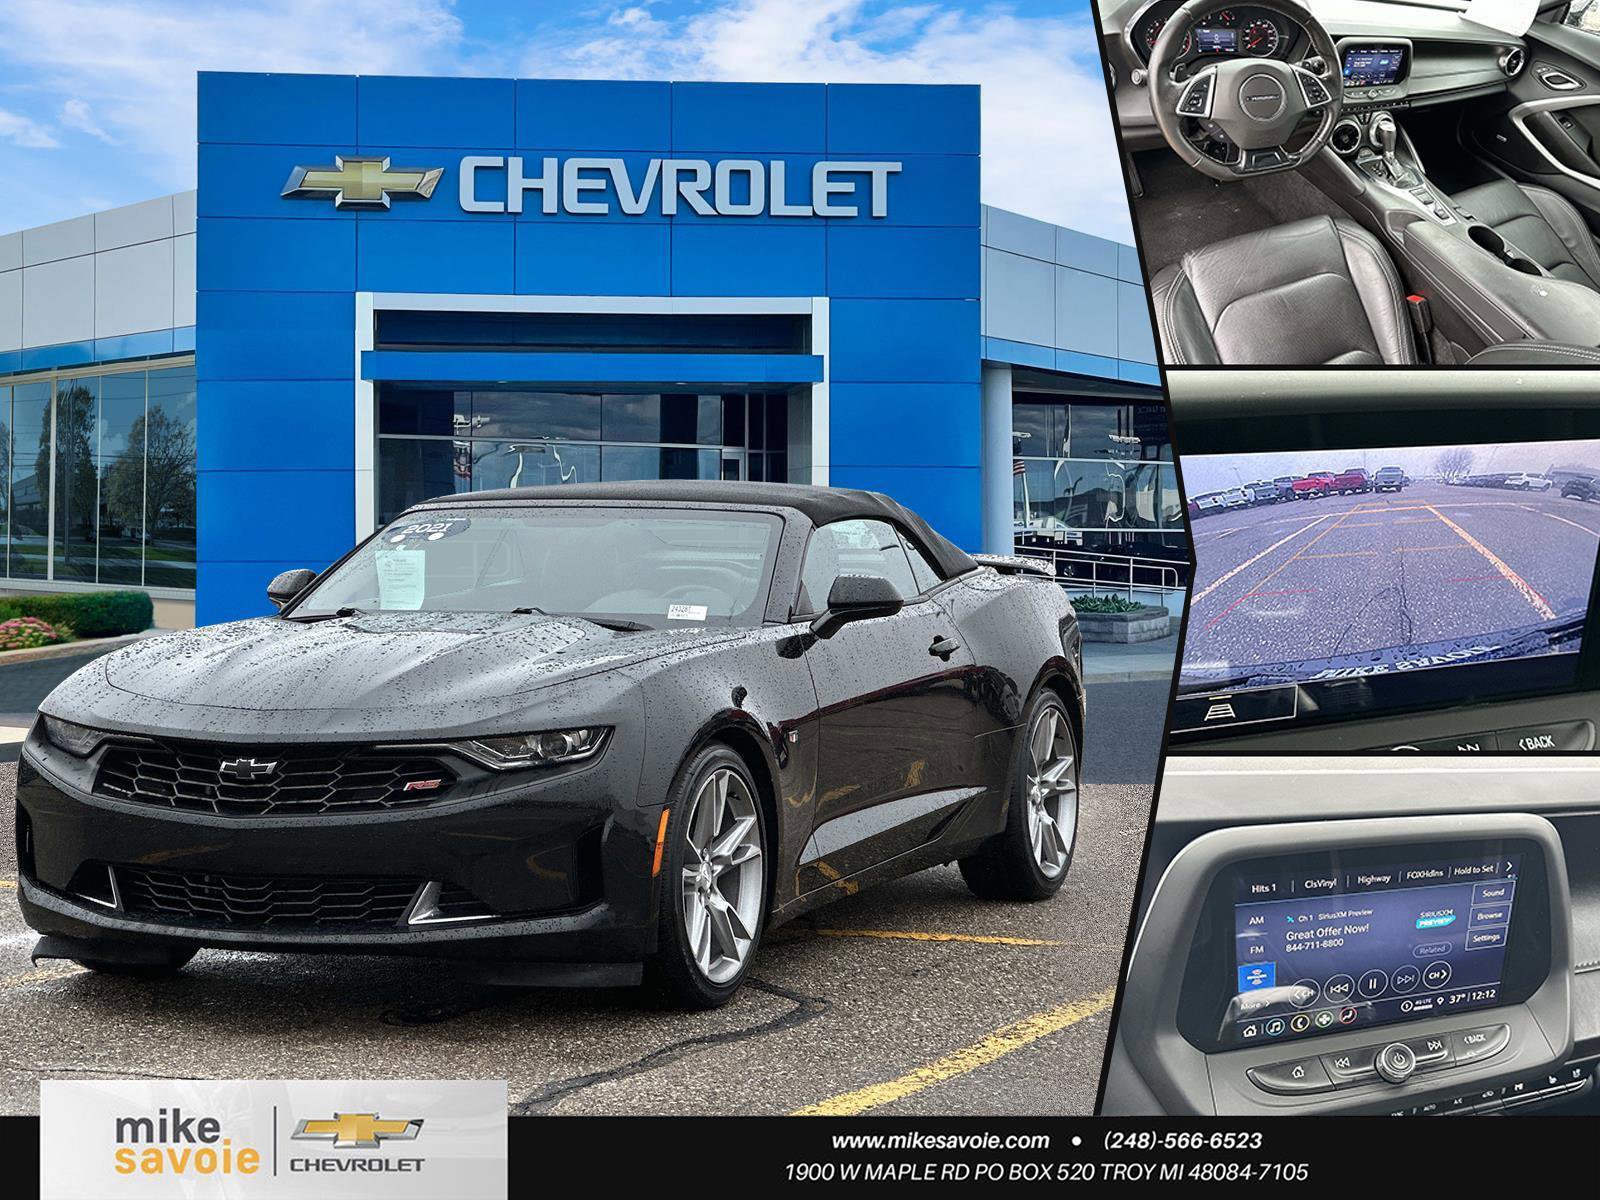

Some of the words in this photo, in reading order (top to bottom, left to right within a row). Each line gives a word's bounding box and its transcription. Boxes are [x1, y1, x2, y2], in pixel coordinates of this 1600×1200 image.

[459, 155, 903, 218] CHEVROLET
[402, 522, 453, 534] 2021
[1525, 735, 1556, 750] BACK
[403, 779, 441, 791] RS
[1454, 867, 1472, 876] Hold
[1472, 866, 1480, 874] to
[1481, 864, 1494, 873] Set
[1357, 873, 1391, 886] Highway
[1251, 884, 1270, 893] Hits
[1271, 883, 1276, 892] 1
[1482, 888, 1505, 897] Sound
[1249, 916, 1265, 925] AM
[1298, 915, 1308, 923] Ch
[1318, 911, 1347, 921] SiriusXM
[1347, 909, 1374, 918] Preview
[1477, 911, 1503, 921] Browse
[1286, 929, 1315, 941] Great
[1316, 925, 1342, 938] Offer
[1343, 923, 1370, 935] Now!
[1472, 933, 1501, 943] Settings
[1250, 945, 1265, 954] FM
[1285, 938, 1344, 953] 844-711-8800
[1420, 945, 1446, 955] Related
[1428, 971, 1440, 980] CH
[1472, 989, 1496, 1000] 12:12
